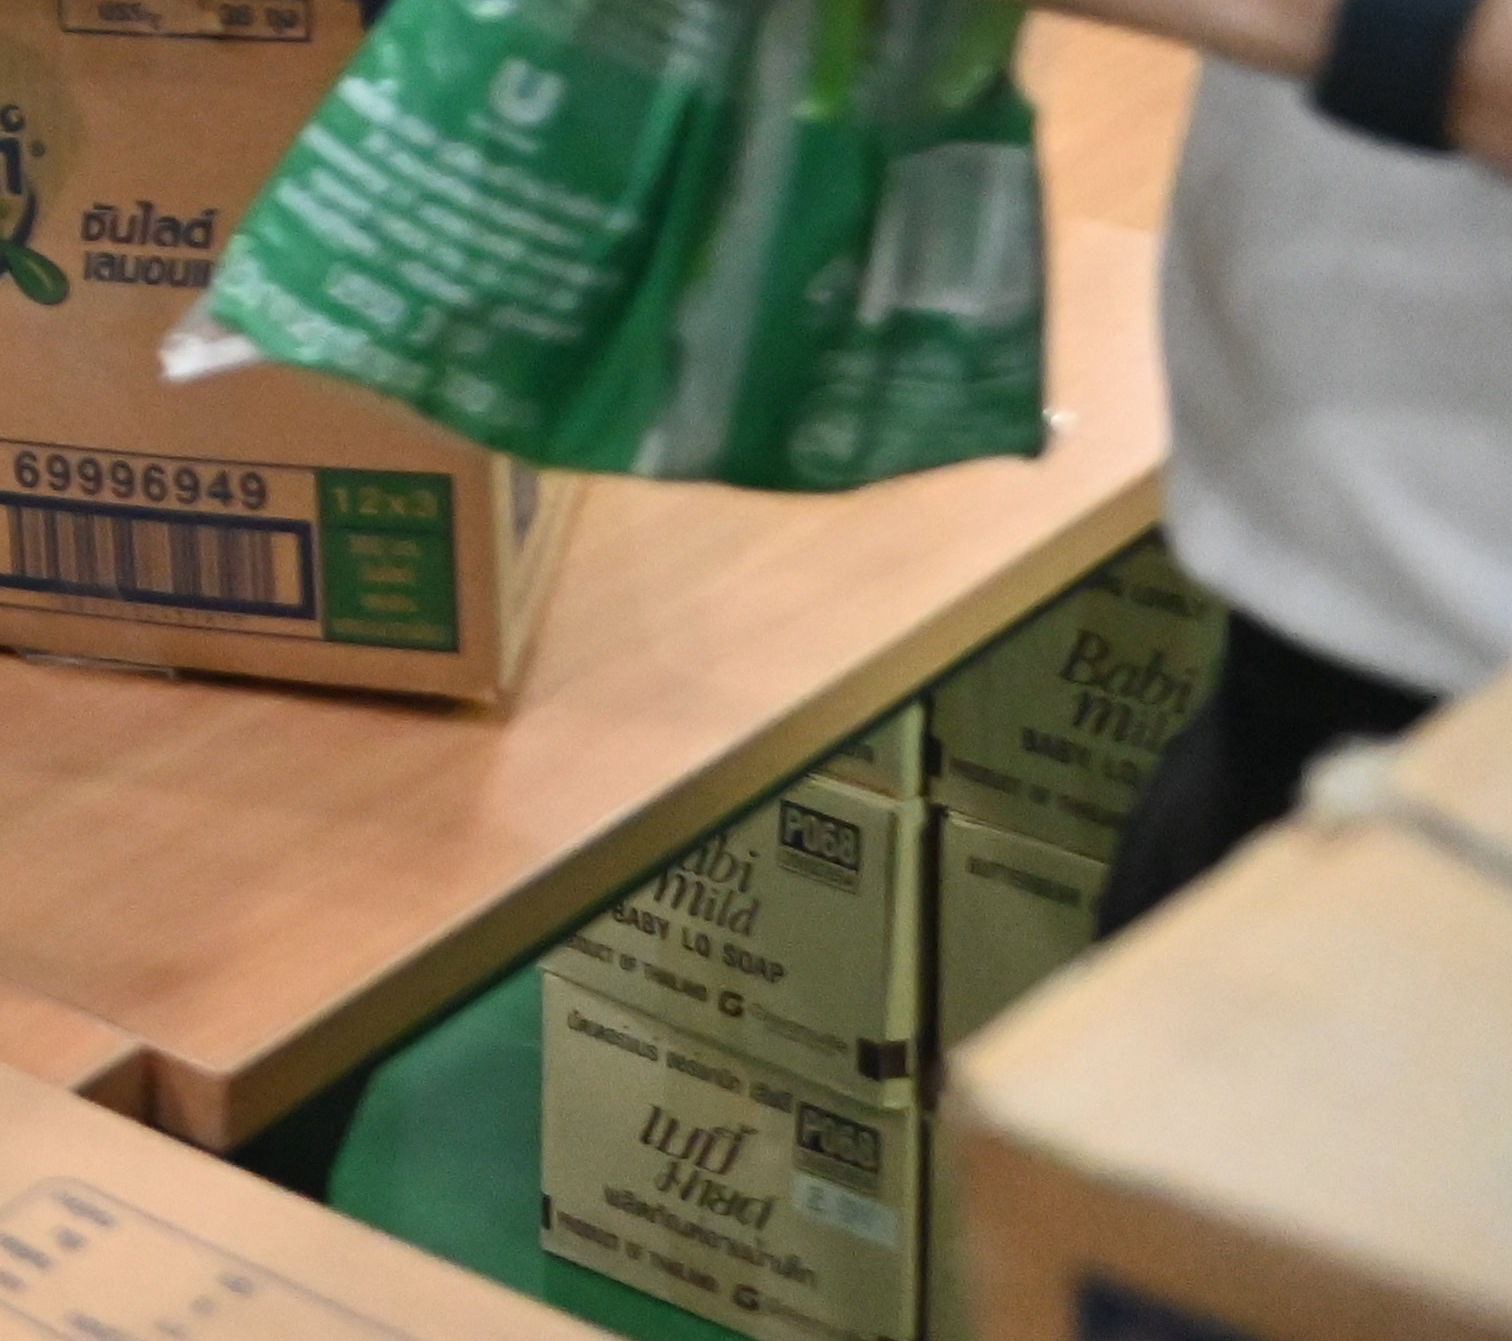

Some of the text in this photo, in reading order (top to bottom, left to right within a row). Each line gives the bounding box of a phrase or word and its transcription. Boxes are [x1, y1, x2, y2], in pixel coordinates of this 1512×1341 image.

[13, 449, 270, 512] 69996949
[681, 924, 712, 960] LQ
[721, 942, 786, 984] SOAP
